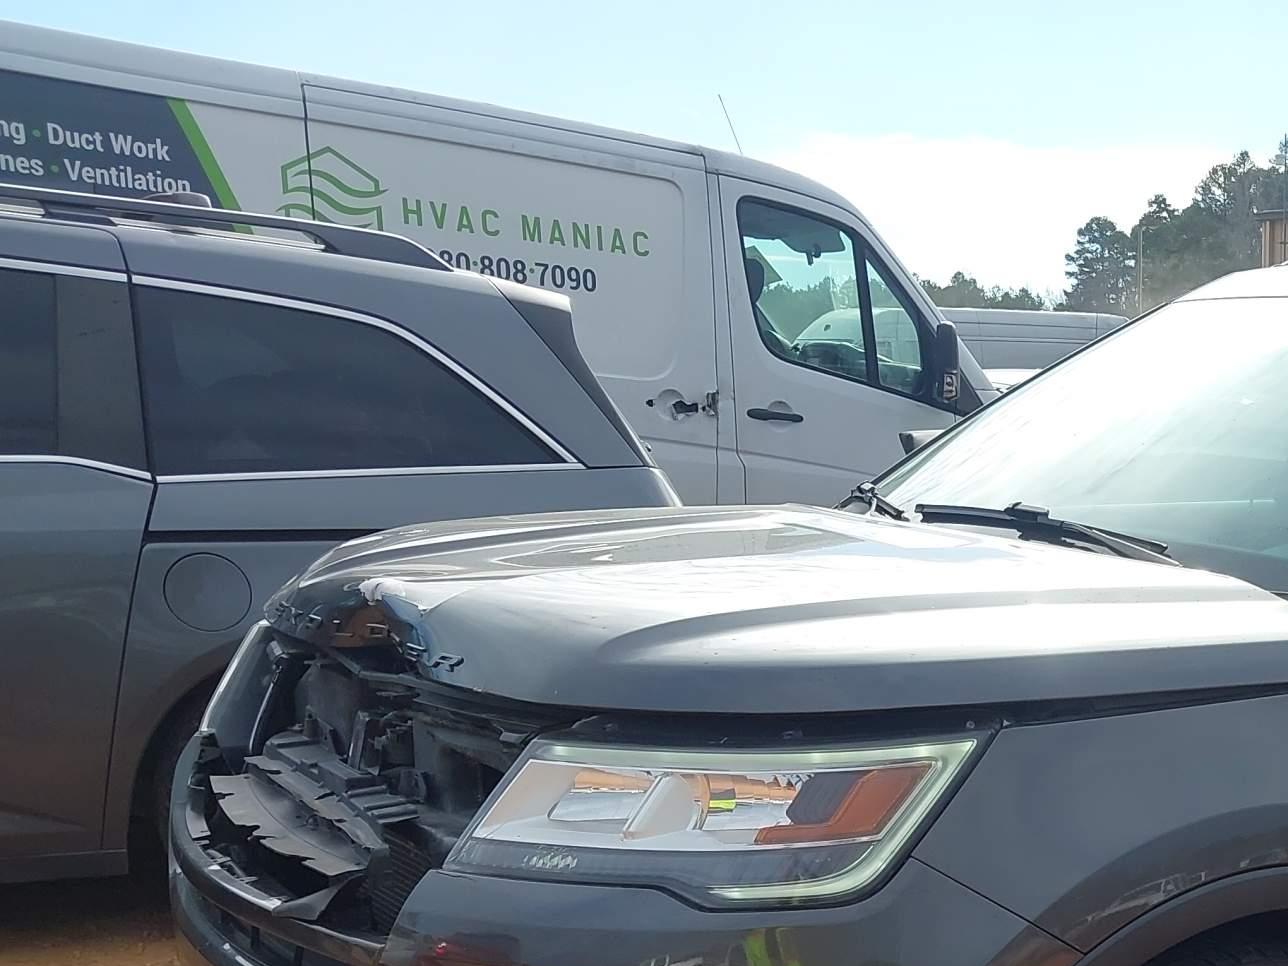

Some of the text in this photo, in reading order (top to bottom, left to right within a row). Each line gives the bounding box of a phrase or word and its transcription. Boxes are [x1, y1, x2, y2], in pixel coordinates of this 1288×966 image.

[47, 122, 104, 153] Duct
[109, 132, 171, 161] Work
[64, 158, 191, 194] Ventilation
[402, 197, 650, 257] HVAC MANIAC
